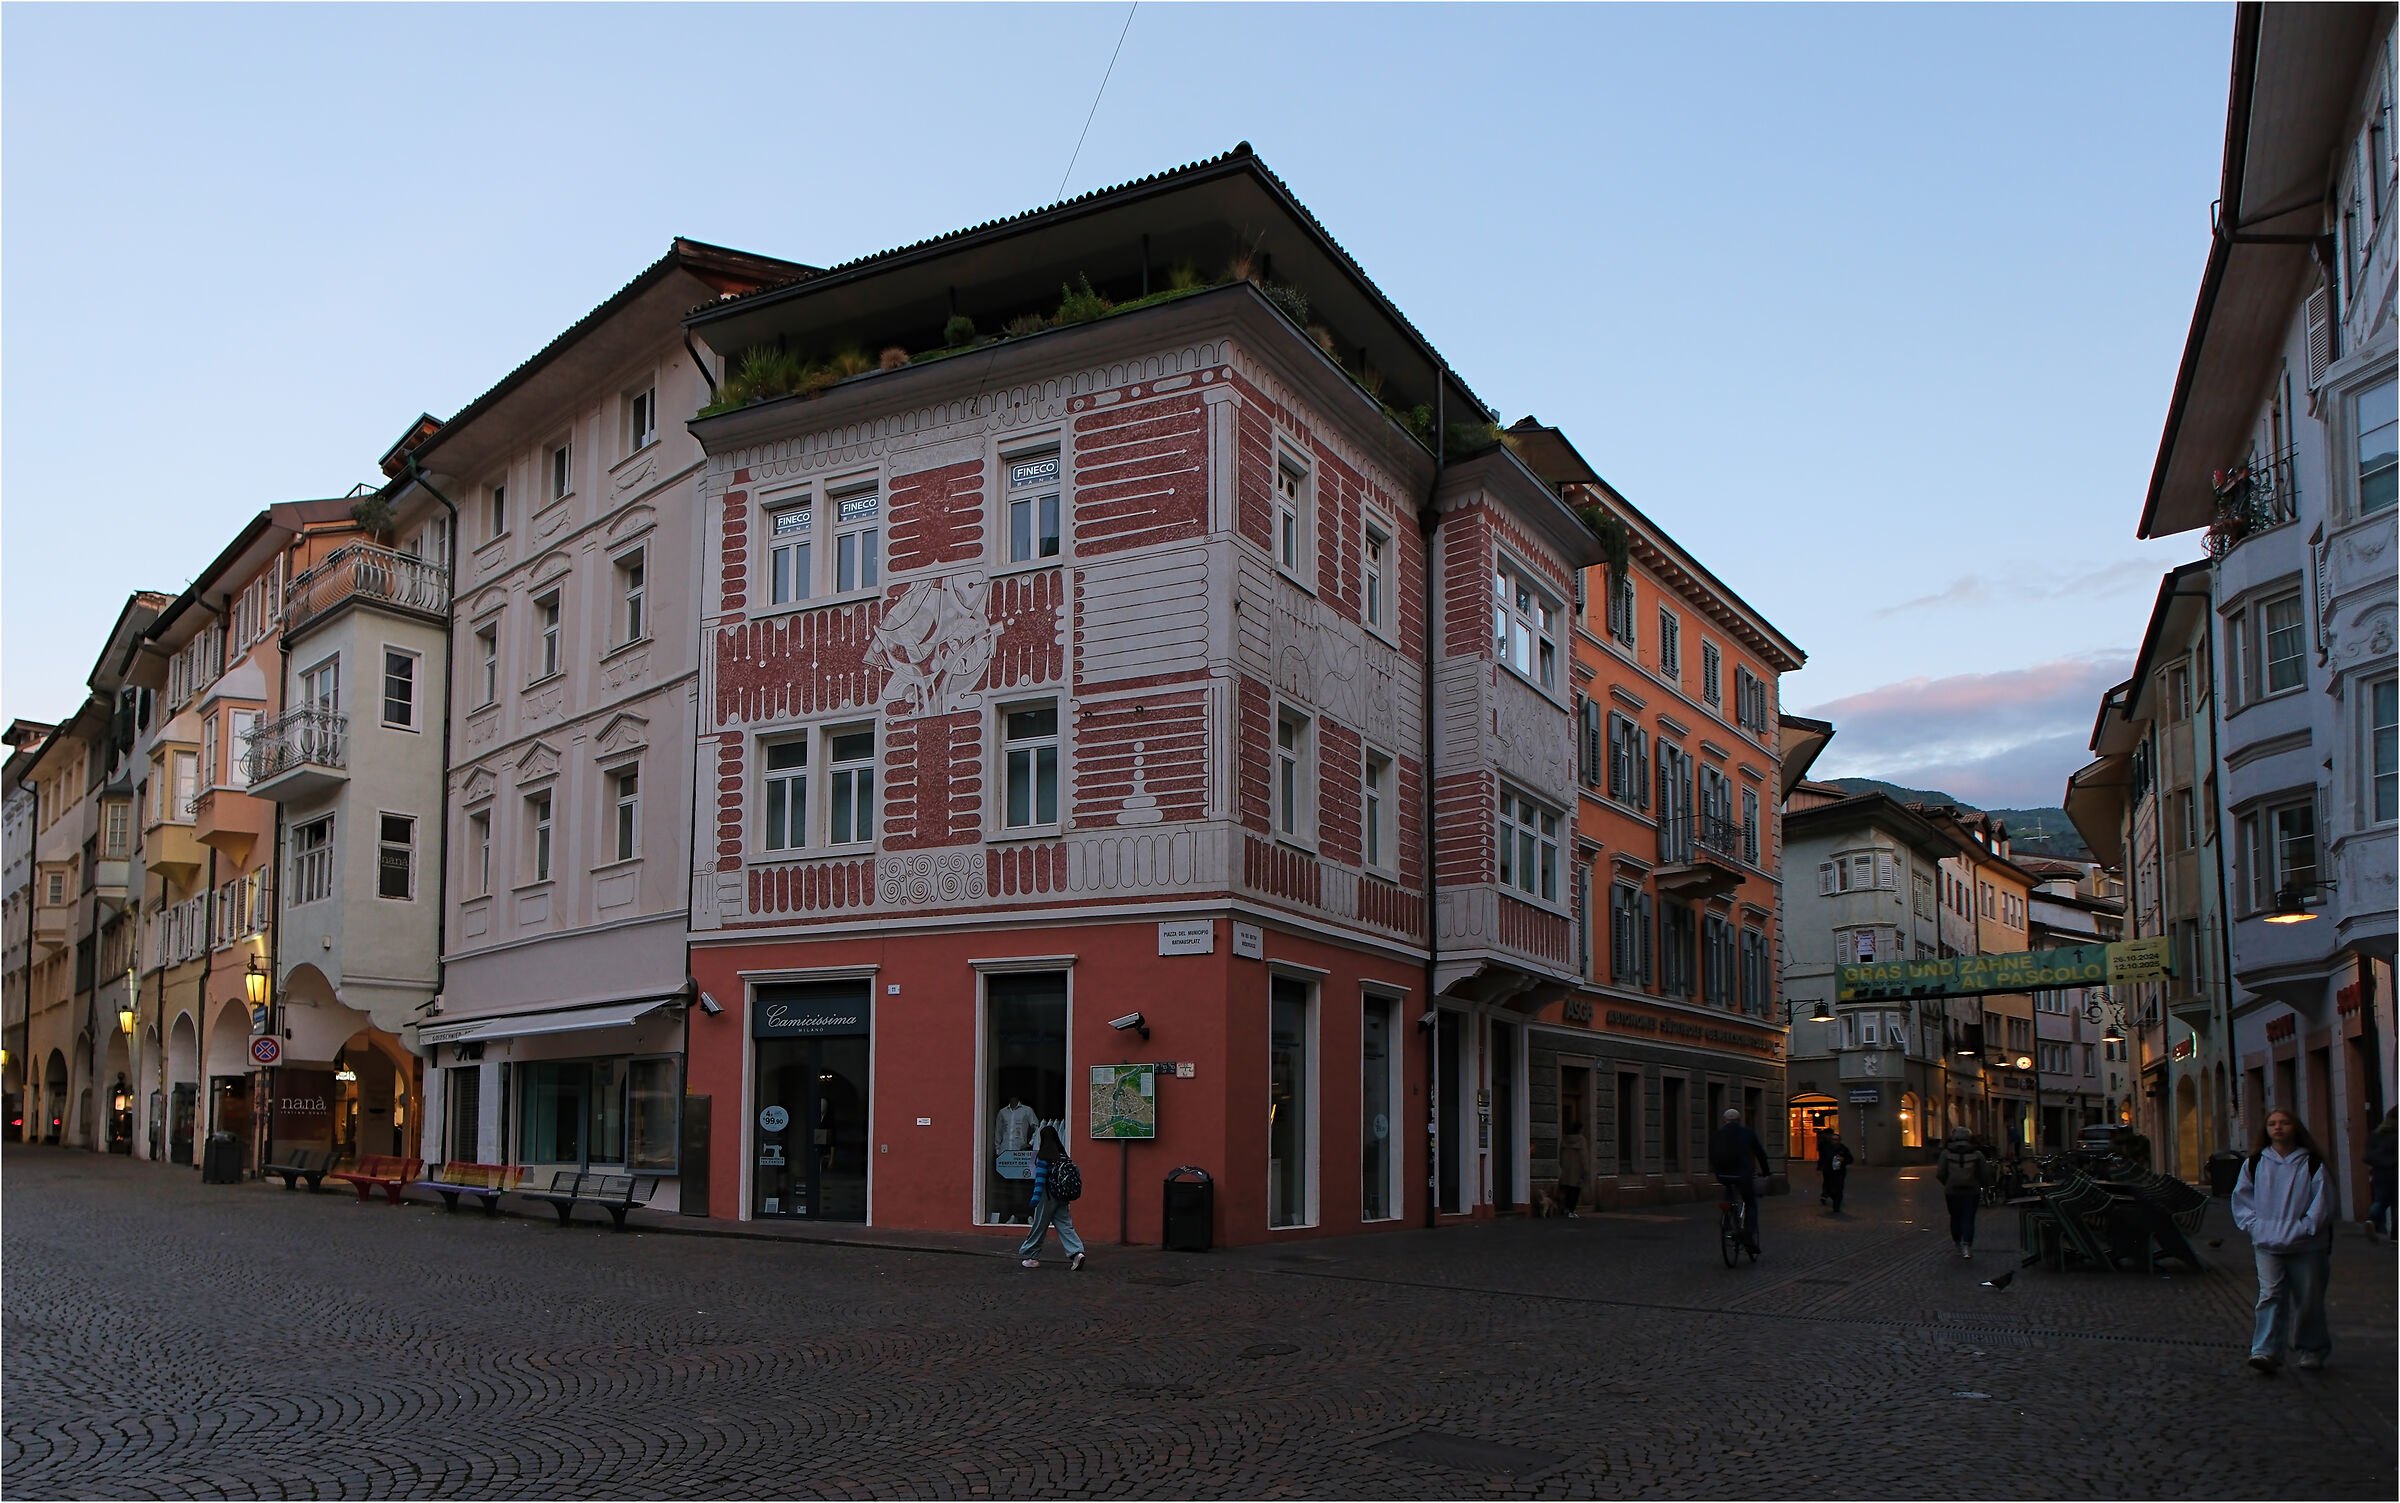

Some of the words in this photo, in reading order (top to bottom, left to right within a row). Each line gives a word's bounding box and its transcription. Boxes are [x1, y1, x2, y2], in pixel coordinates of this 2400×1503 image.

[1017, 463, 1055, 478] FINECO
[843, 498, 877, 512] FINECO
[778, 512, 810, 526] FINECO
[1844, 965, 1901, 981] GRAS
[1908, 961, 1954, 978] UND
[2115, 961, 2160, 970] 12.10.2025
[1961, 975, 1990, 989] AL
[1996, 964, 2101, 985] PASCOLO
[766, 1004, 857, 1028] Camicissima
[1565, 999, 1593, 1022] ASGB
[281, 1096, 327, 1110] nanà
